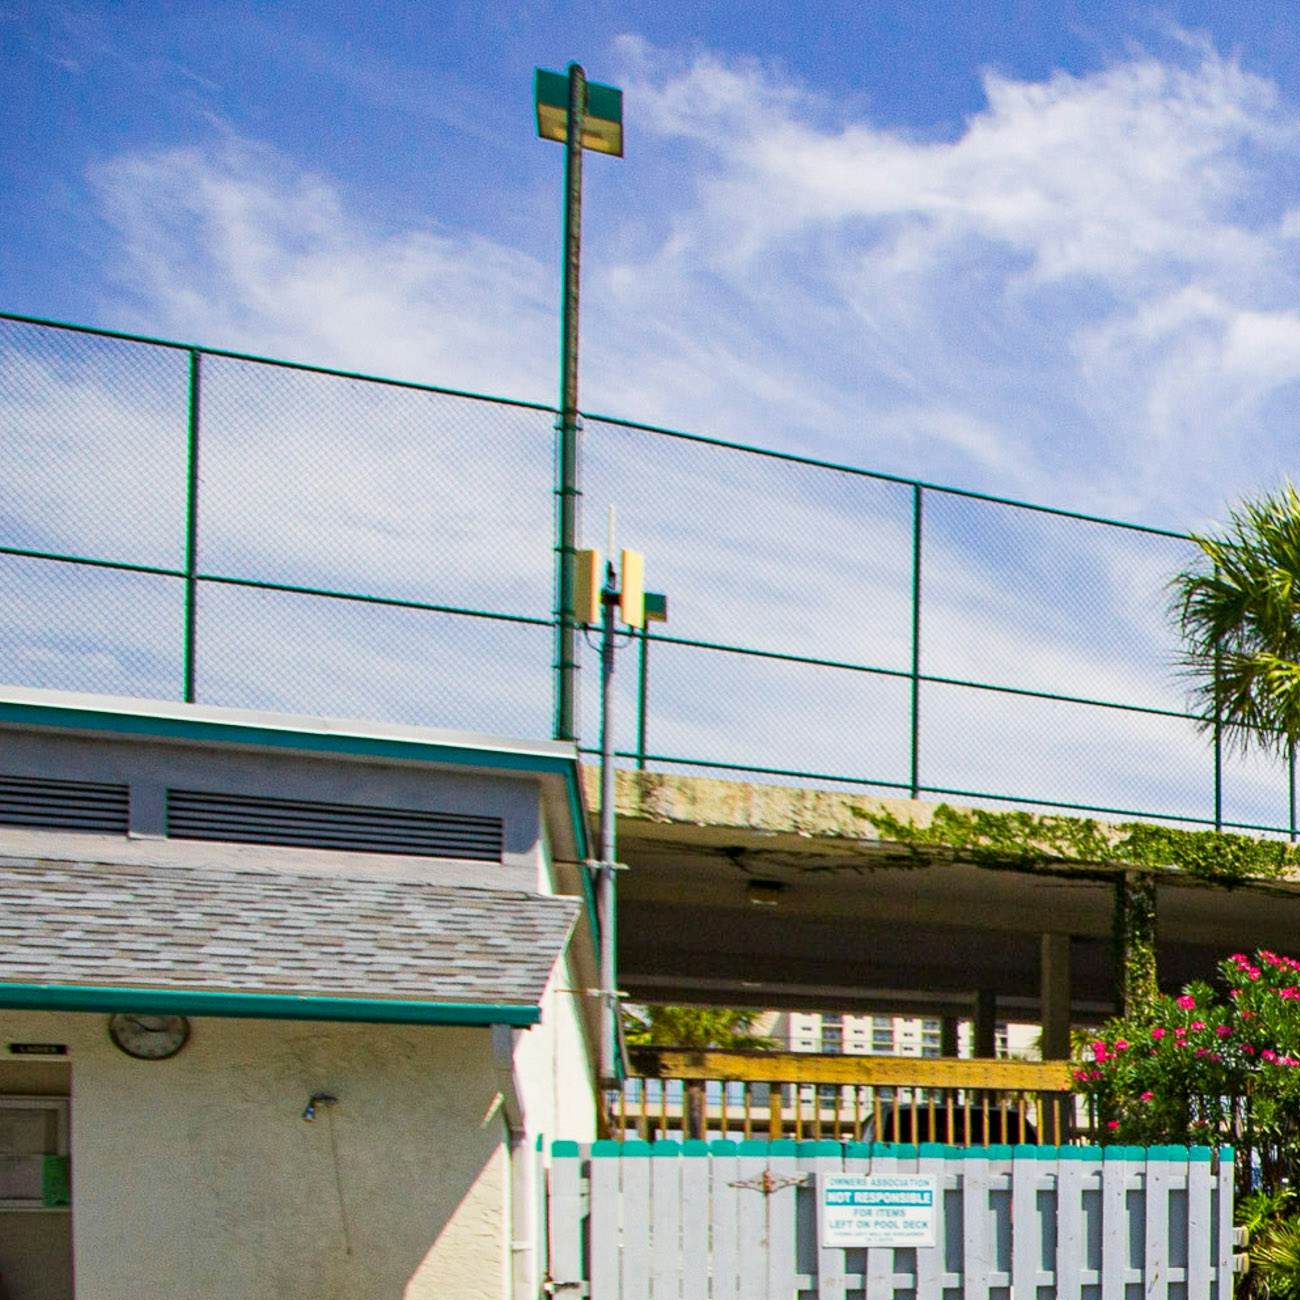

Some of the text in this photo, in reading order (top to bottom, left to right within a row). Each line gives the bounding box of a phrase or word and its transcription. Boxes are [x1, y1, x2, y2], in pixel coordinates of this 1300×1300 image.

[871, 1178, 930, 1188] ASSOCIATION
[827, 1191, 931, 1204] NOT RESPONSIBLE
[830, 1220, 852, 1229] LEFT
[874, 1220, 899, 1229] POOL
[903, 1220, 928, 1230] DECK
